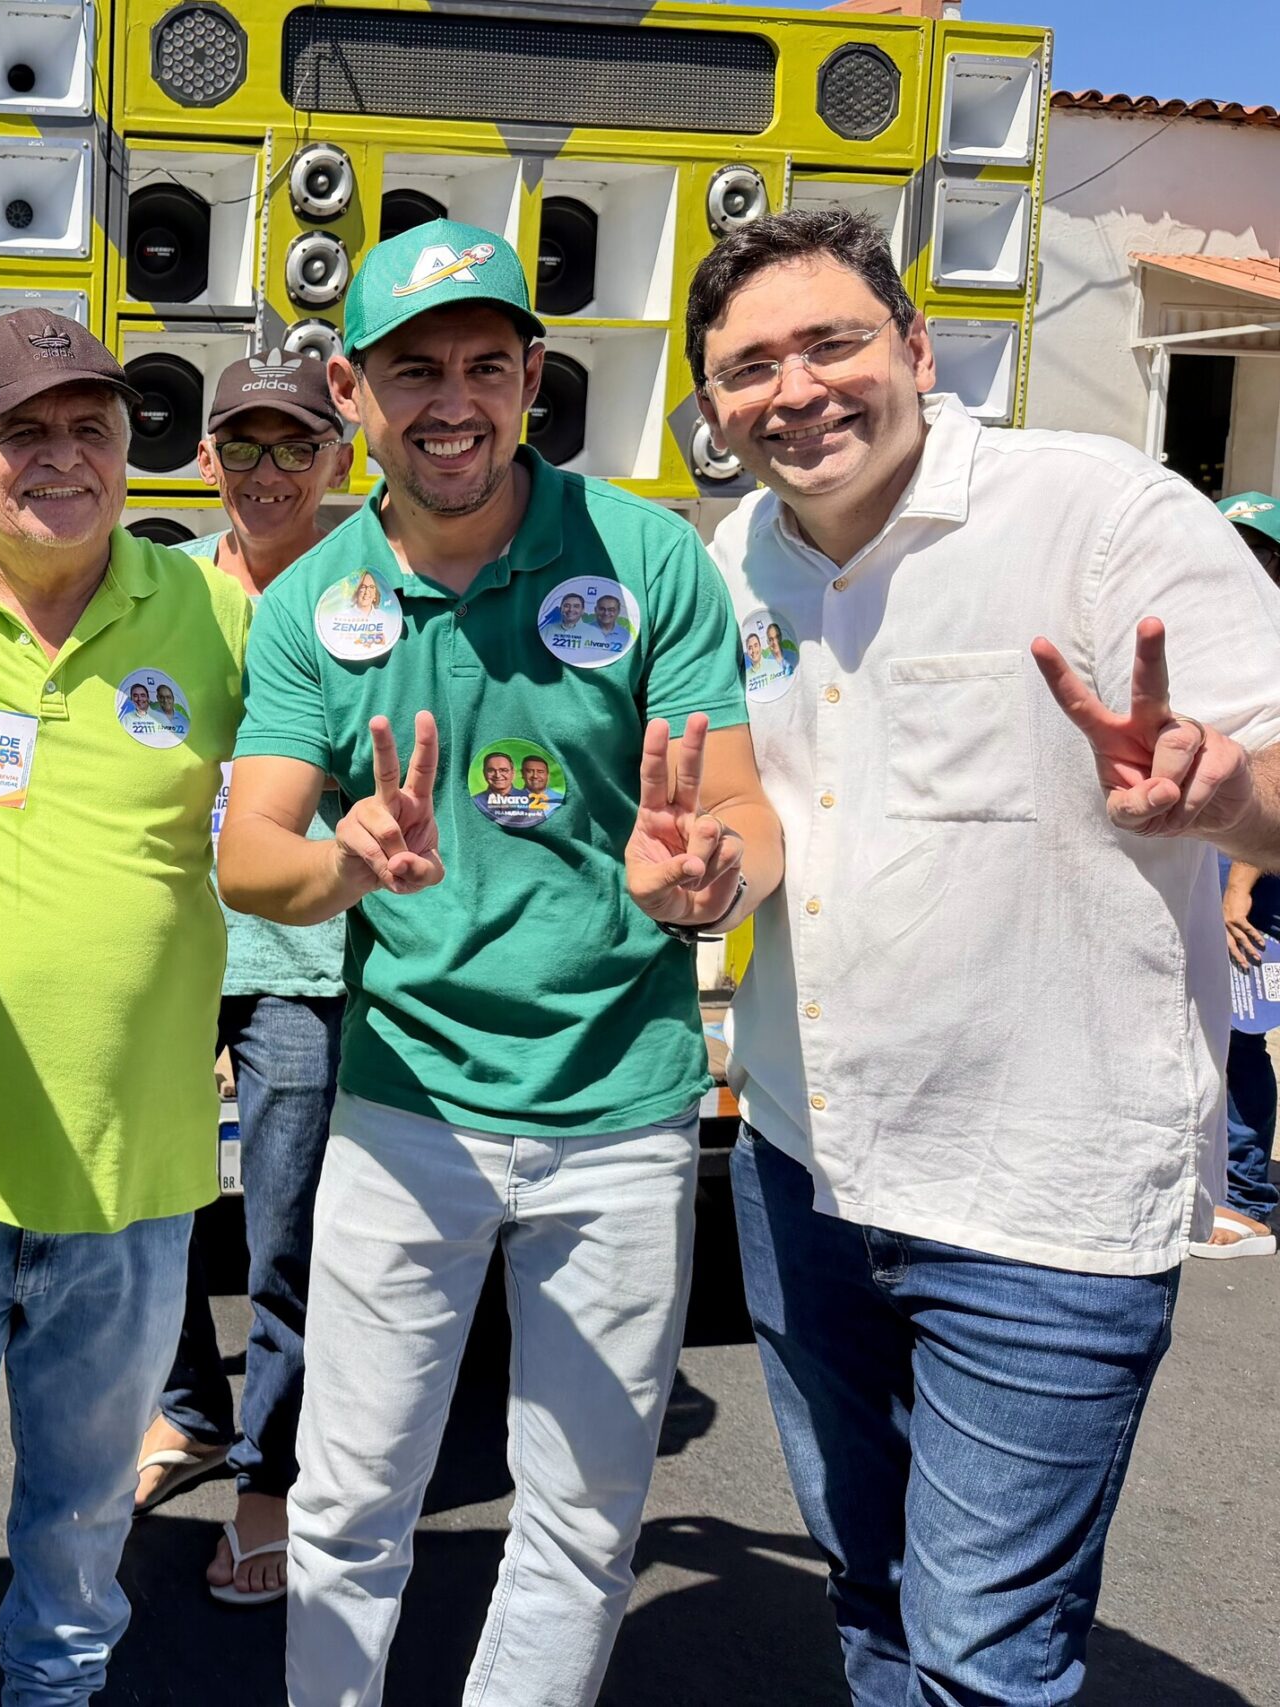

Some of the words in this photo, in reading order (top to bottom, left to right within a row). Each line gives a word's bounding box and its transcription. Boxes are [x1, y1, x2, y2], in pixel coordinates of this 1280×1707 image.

[241, 379, 298, 393] adidas
[332, 622, 384, 632] ZENAIDE
[360, 633, 384, 645] 555
[552, 638, 581, 649] 22111
[610, 641, 622, 653] 22
[133, 726, 156, 734] 22111
[487, 793, 529, 805] Alvaro
[223, 1176, 236, 1189] BR
